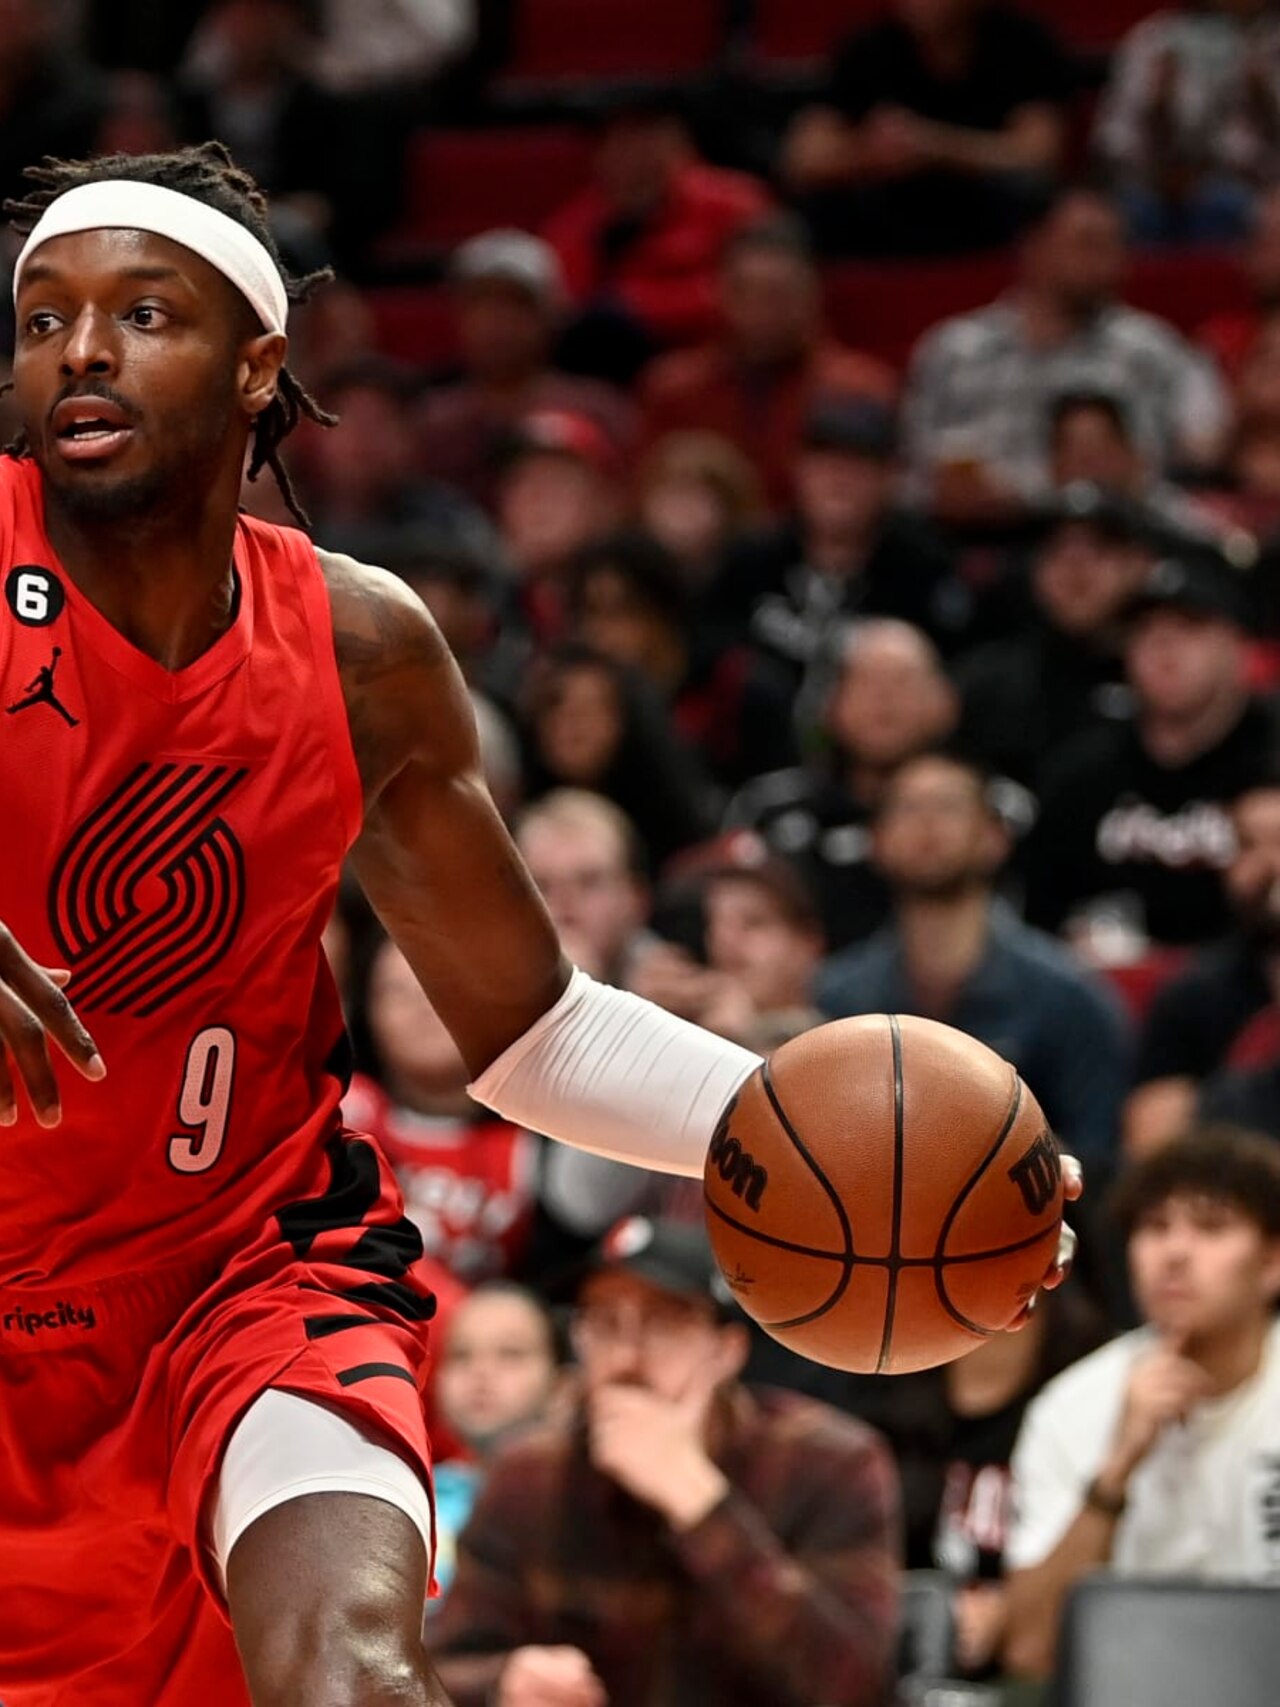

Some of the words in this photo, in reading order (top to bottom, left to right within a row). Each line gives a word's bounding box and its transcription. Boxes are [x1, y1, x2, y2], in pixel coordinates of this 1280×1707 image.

[16, 573, 49, 620] 6
[167, 1025, 237, 1175] 9
[3, 1301, 96, 1336] ripcity
